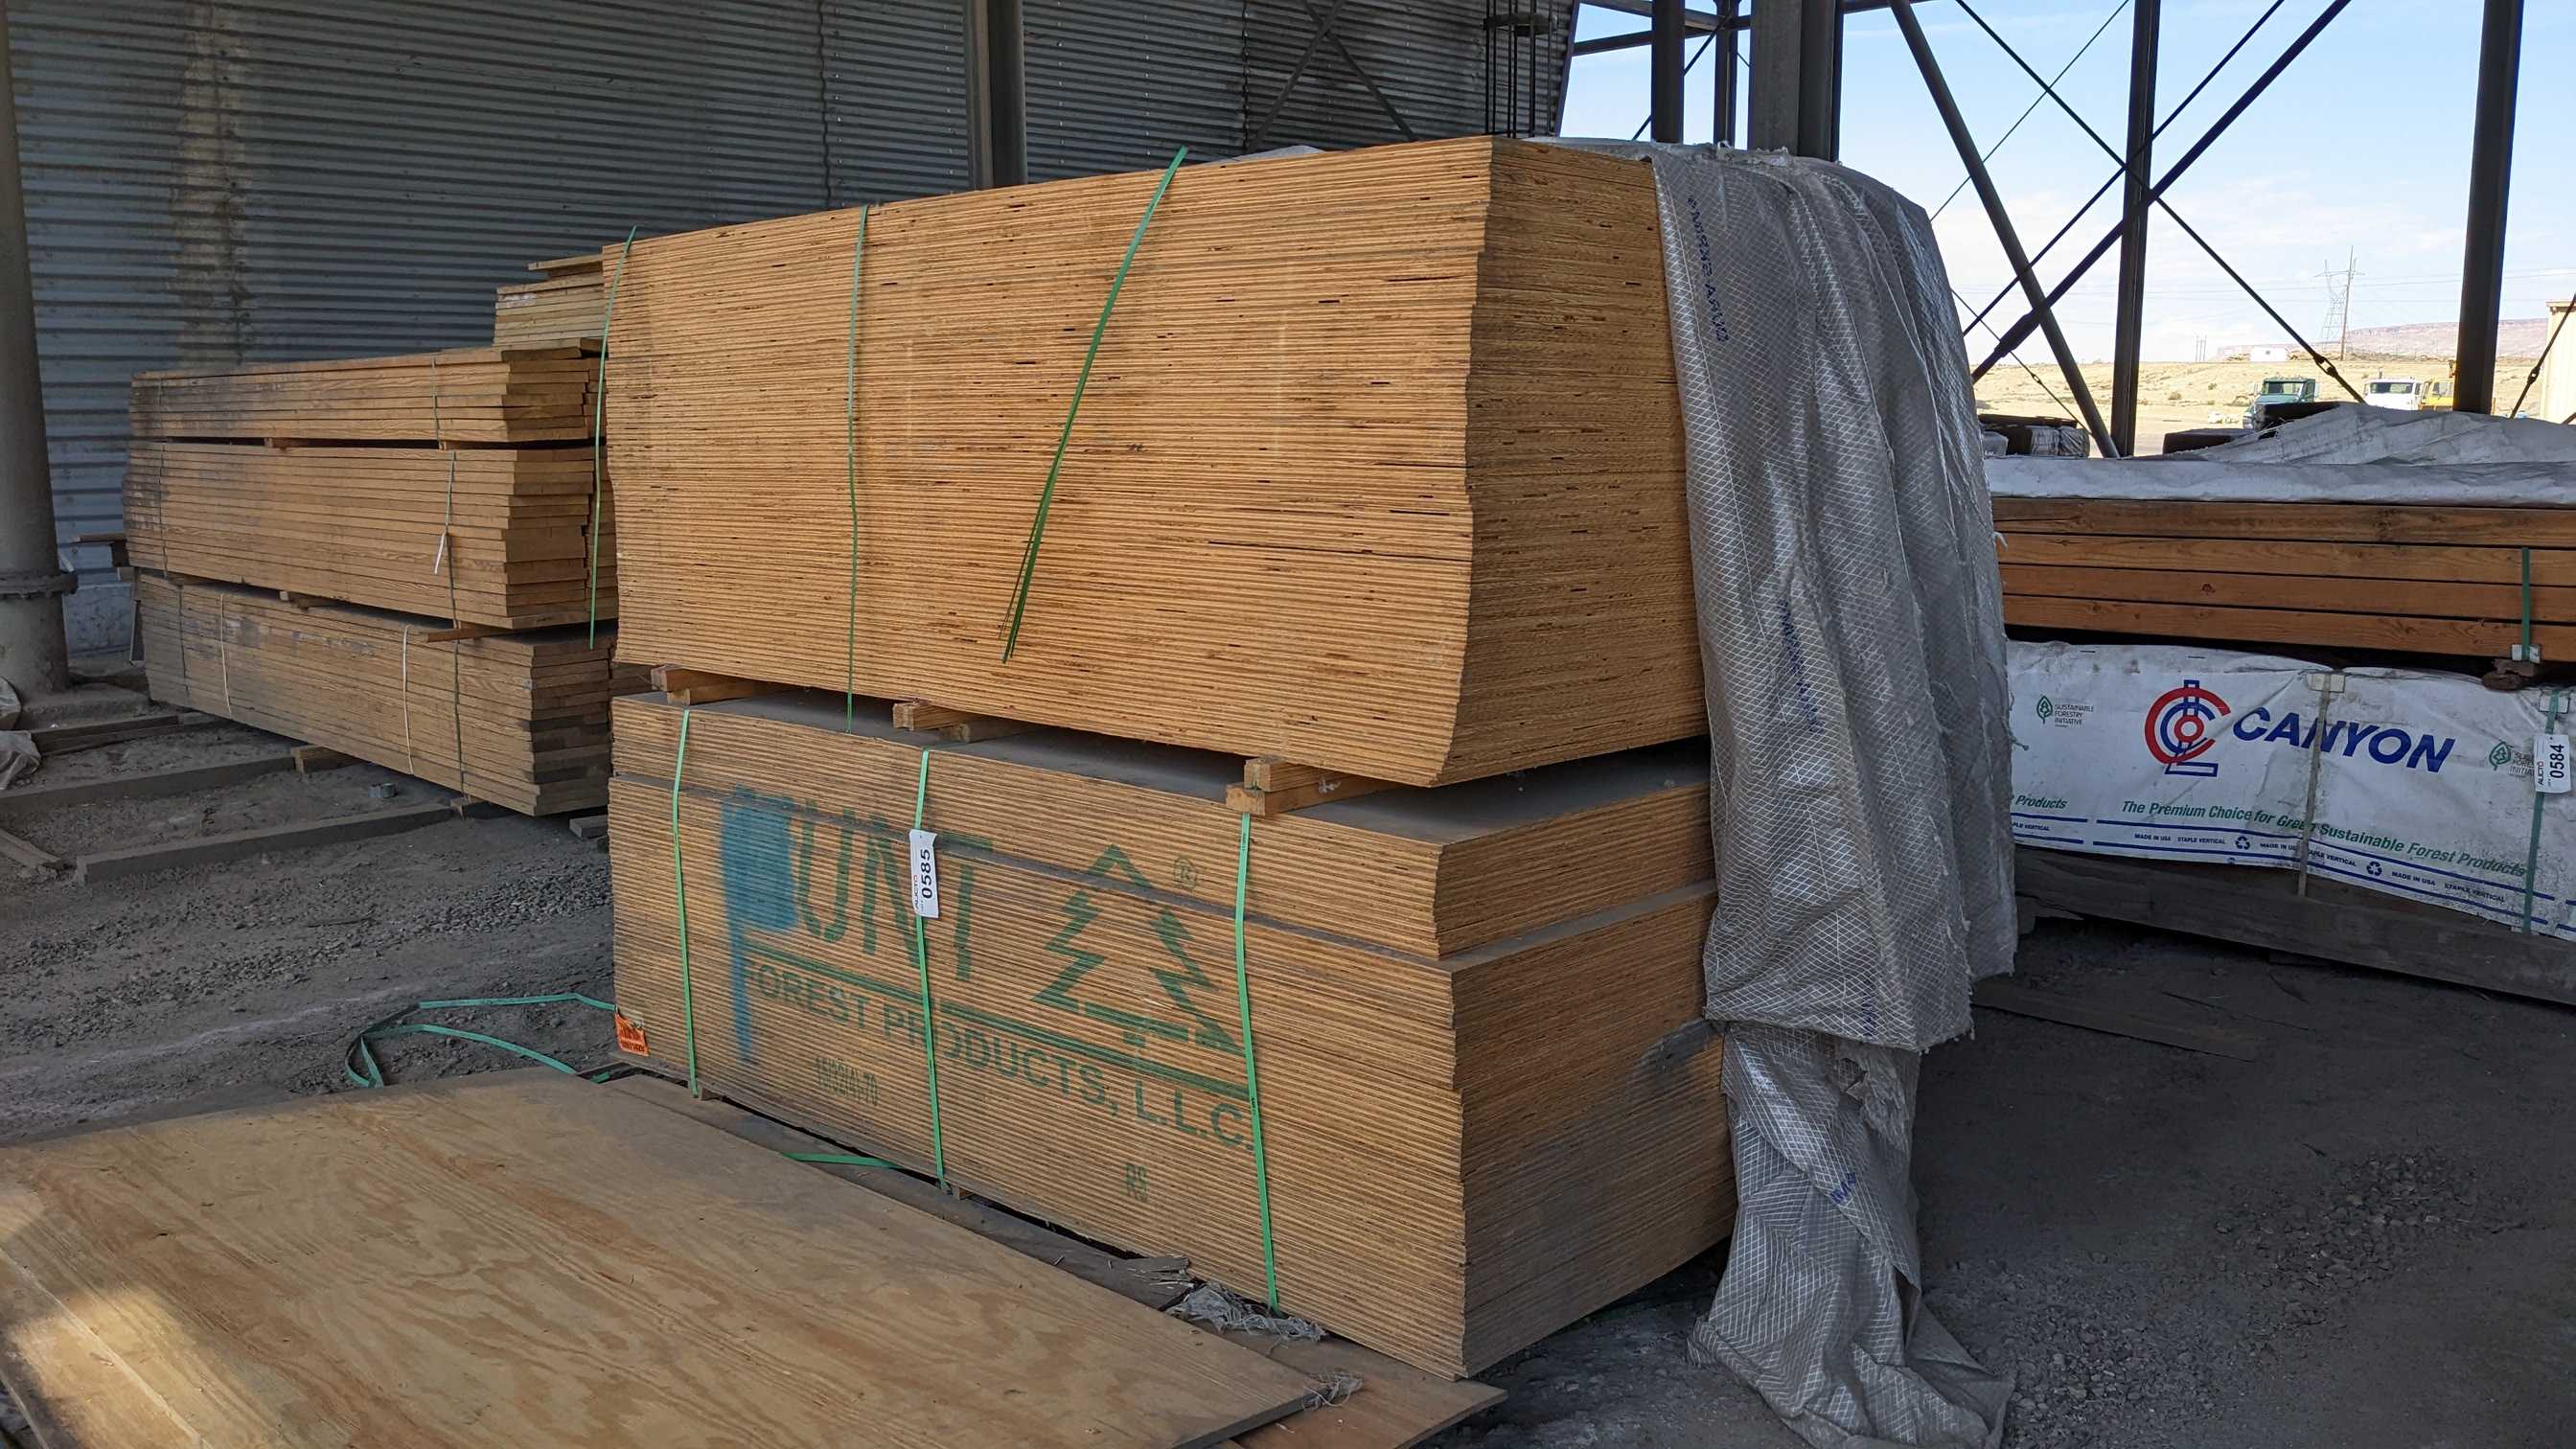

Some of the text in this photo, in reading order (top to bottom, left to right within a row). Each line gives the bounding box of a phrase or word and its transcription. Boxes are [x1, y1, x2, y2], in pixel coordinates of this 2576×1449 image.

[2233, 706, 2456, 773] CANYON
[2549, 744, 2564, 779] 0584
[2015, 794, 2068, 810] Products
[2122, 800, 2145, 815] The
[2149, 802, 2206, 818] Premium
[2209, 805, 2252, 821] Choice
[2253, 809, 2276, 824] for
[2318, 822, 2405, 853] Sustainable
[2407, 842, 2456, 863] Forest
[2457, 853, 2527, 878] Products
[920, 848, 932, 899] 0585
[2391, 870, 2411, 881] MADE
[2422, 878, 2436, 886] USA
